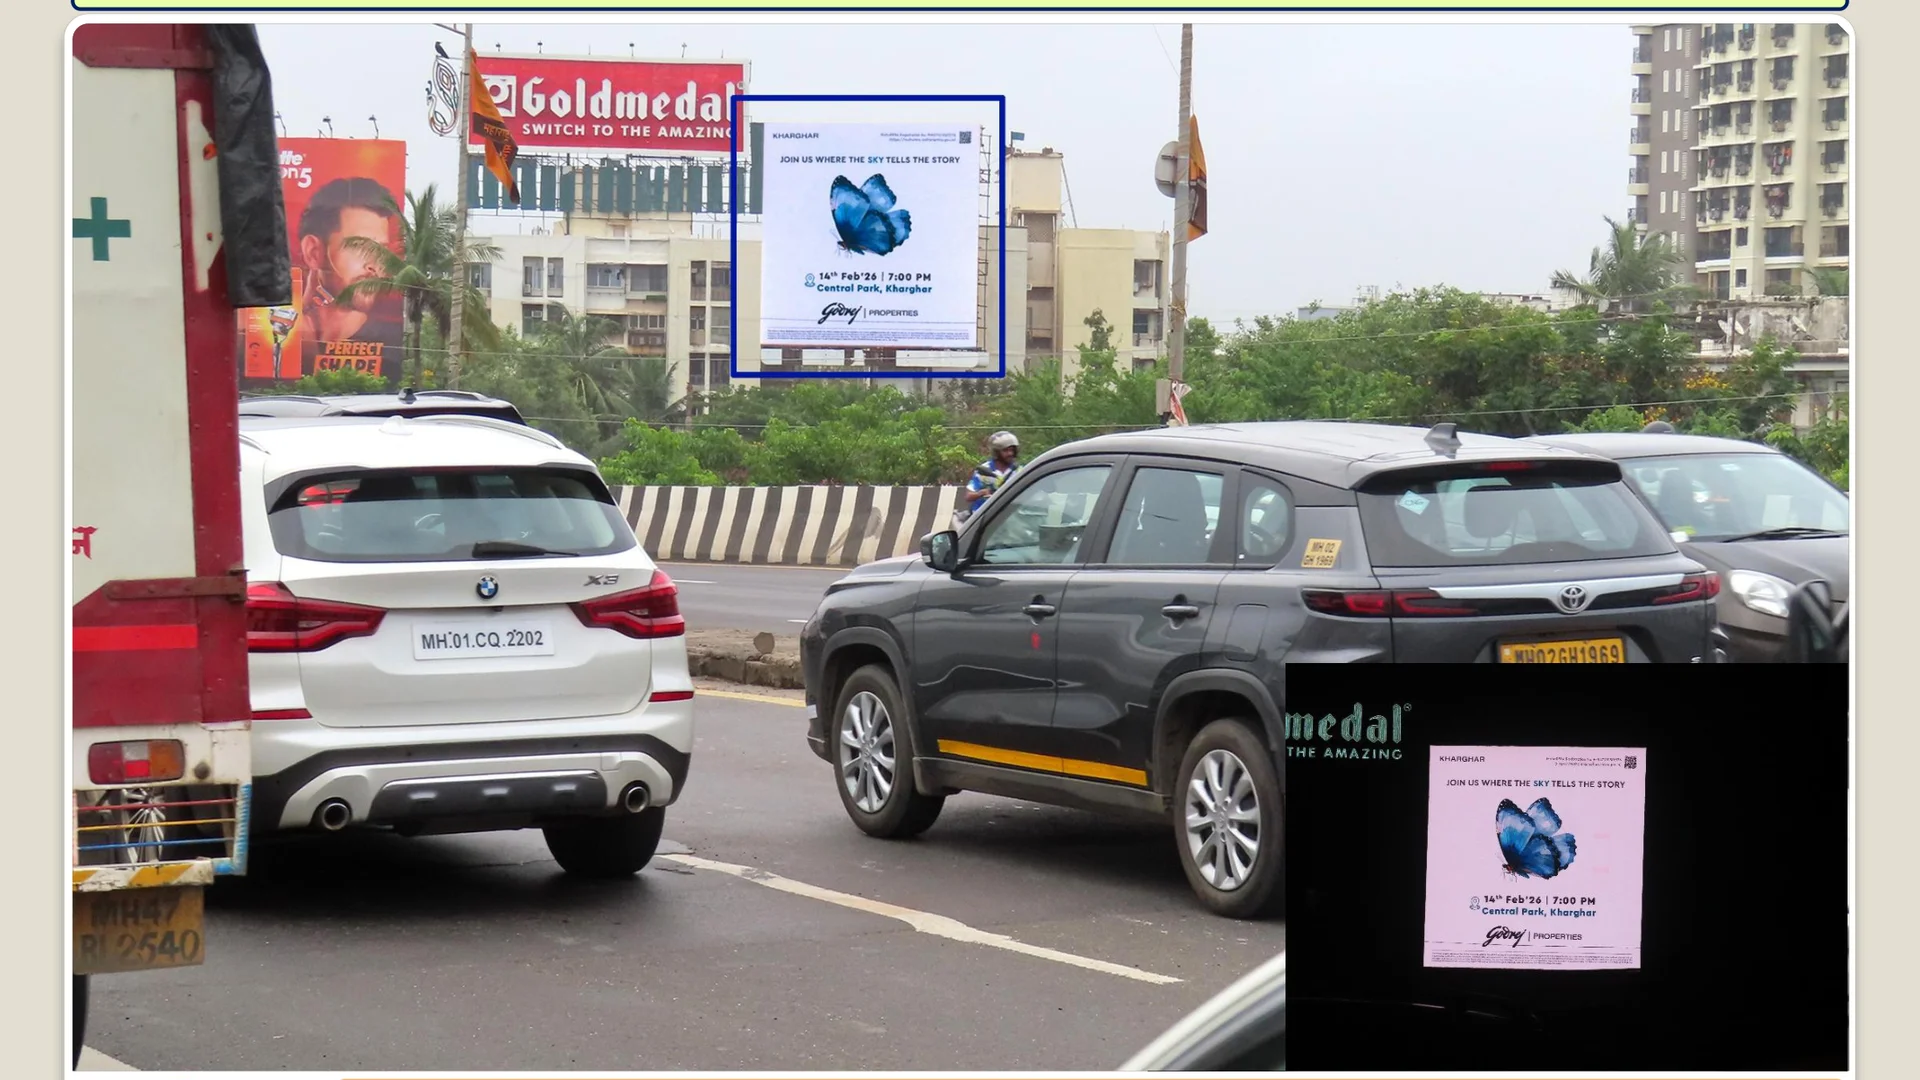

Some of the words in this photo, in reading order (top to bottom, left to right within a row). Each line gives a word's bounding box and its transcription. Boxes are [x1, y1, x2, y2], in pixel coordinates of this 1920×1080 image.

[522, 76, 735, 123] Goldmedal
[522, 123, 586, 136] SWITCH
[593, 124, 614, 137] TO
[620, 124, 650, 137] THE
[867, 156, 884, 164] SKY
[885, 156, 911, 164] TELLS
[912, 156, 930, 164] THE
[931, 156, 961, 164] STORY
[819, 271, 838, 281] 14th
[888, 272, 912, 282] 7:00
[916, 273, 932, 282] PM
[817, 283, 855, 293] Central
[857, 284, 883, 294] Park,
[885, 284, 933, 294] Kharghar
[817, 302, 863, 324] Godrej
[868, 309, 919, 317] PROPERTIES
[325, 342, 384, 355] PERFECT
[583, 574, 619, 587] X3
[1286, 746, 1316, 758] THE
[1323, 747, 1403, 760] AMAZING
[1439, 755, 1486, 763] KHARGHAR
[1446, 779, 1466, 787] JOIN
[1468, 779, 1480, 787] US
[1481, 779, 1513, 787] WHERE
[1533, 780, 1550, 788] SKY
[1551, 780, 1576, 788] TELLS
[1597, 781, 1626, 789] STORY
[1552, 896, 1576, 905] 7:00
[1580, 897, 1596, 905] PM
[1482, 907, 1519, 916] Central
[1521, 908, 1547, 918] Park,
[1550, 908, 1597, 918] Kharghar
[1482, 926, 1528, 948] Godrej
[1533, 932, 1583, 941] PROPERTIES
